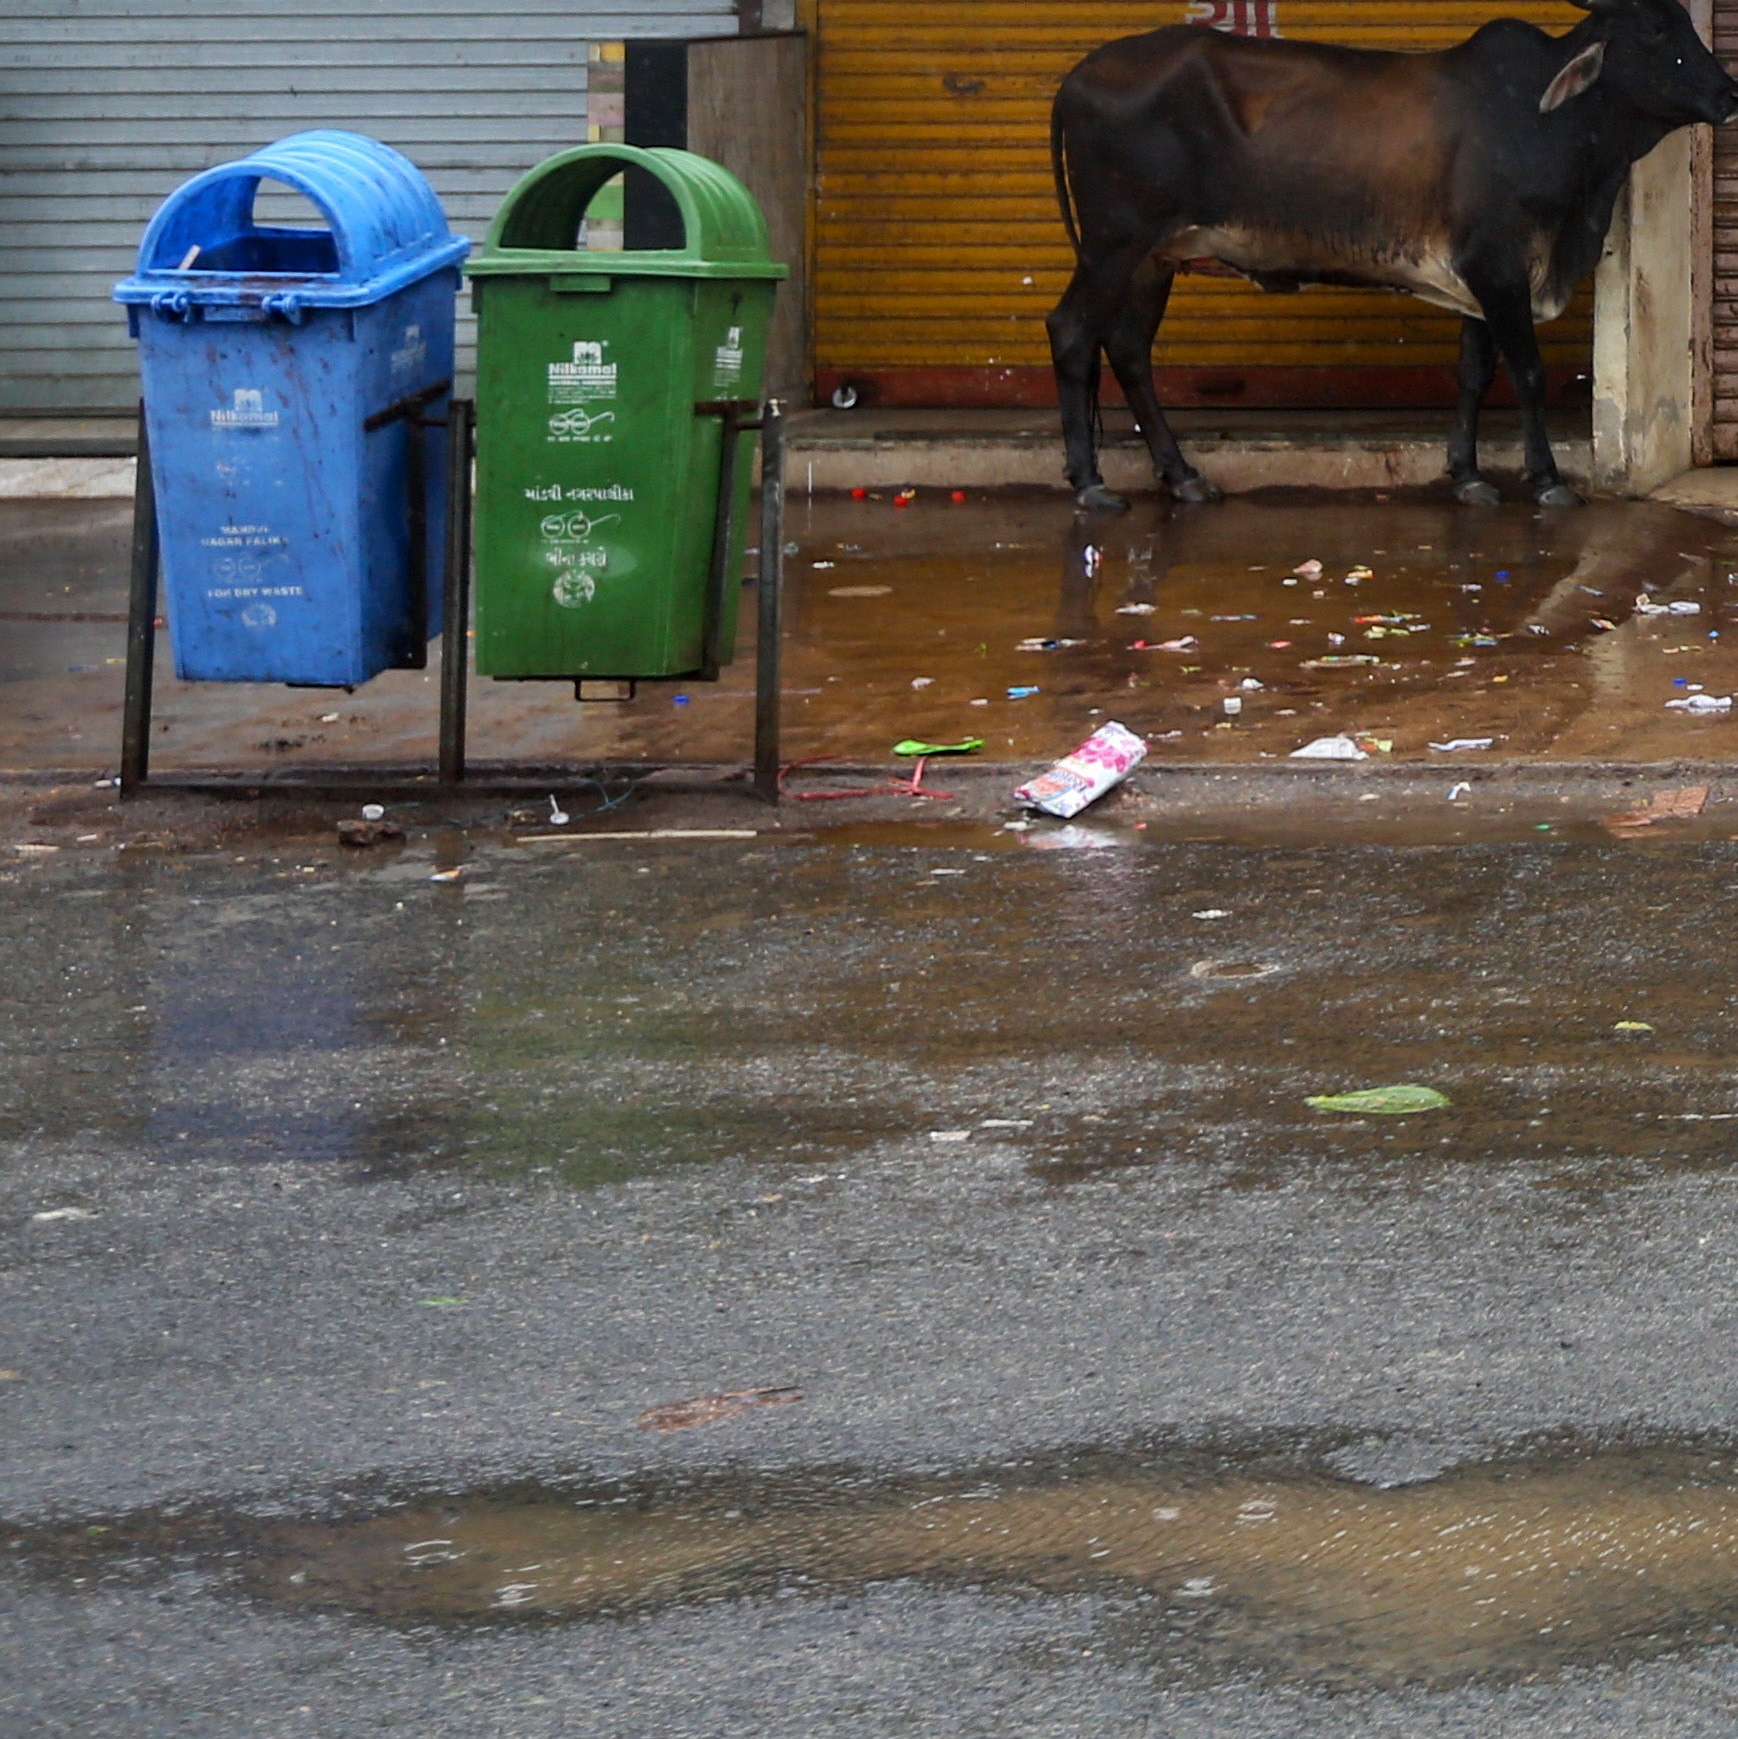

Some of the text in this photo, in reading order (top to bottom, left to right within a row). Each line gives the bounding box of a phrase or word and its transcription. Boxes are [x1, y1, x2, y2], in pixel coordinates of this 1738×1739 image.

[548, 362, 617, 375] Nilkamal
[210, 409, 279, 422] Nilkamal
[261, 585, 304, 597] WASTE
